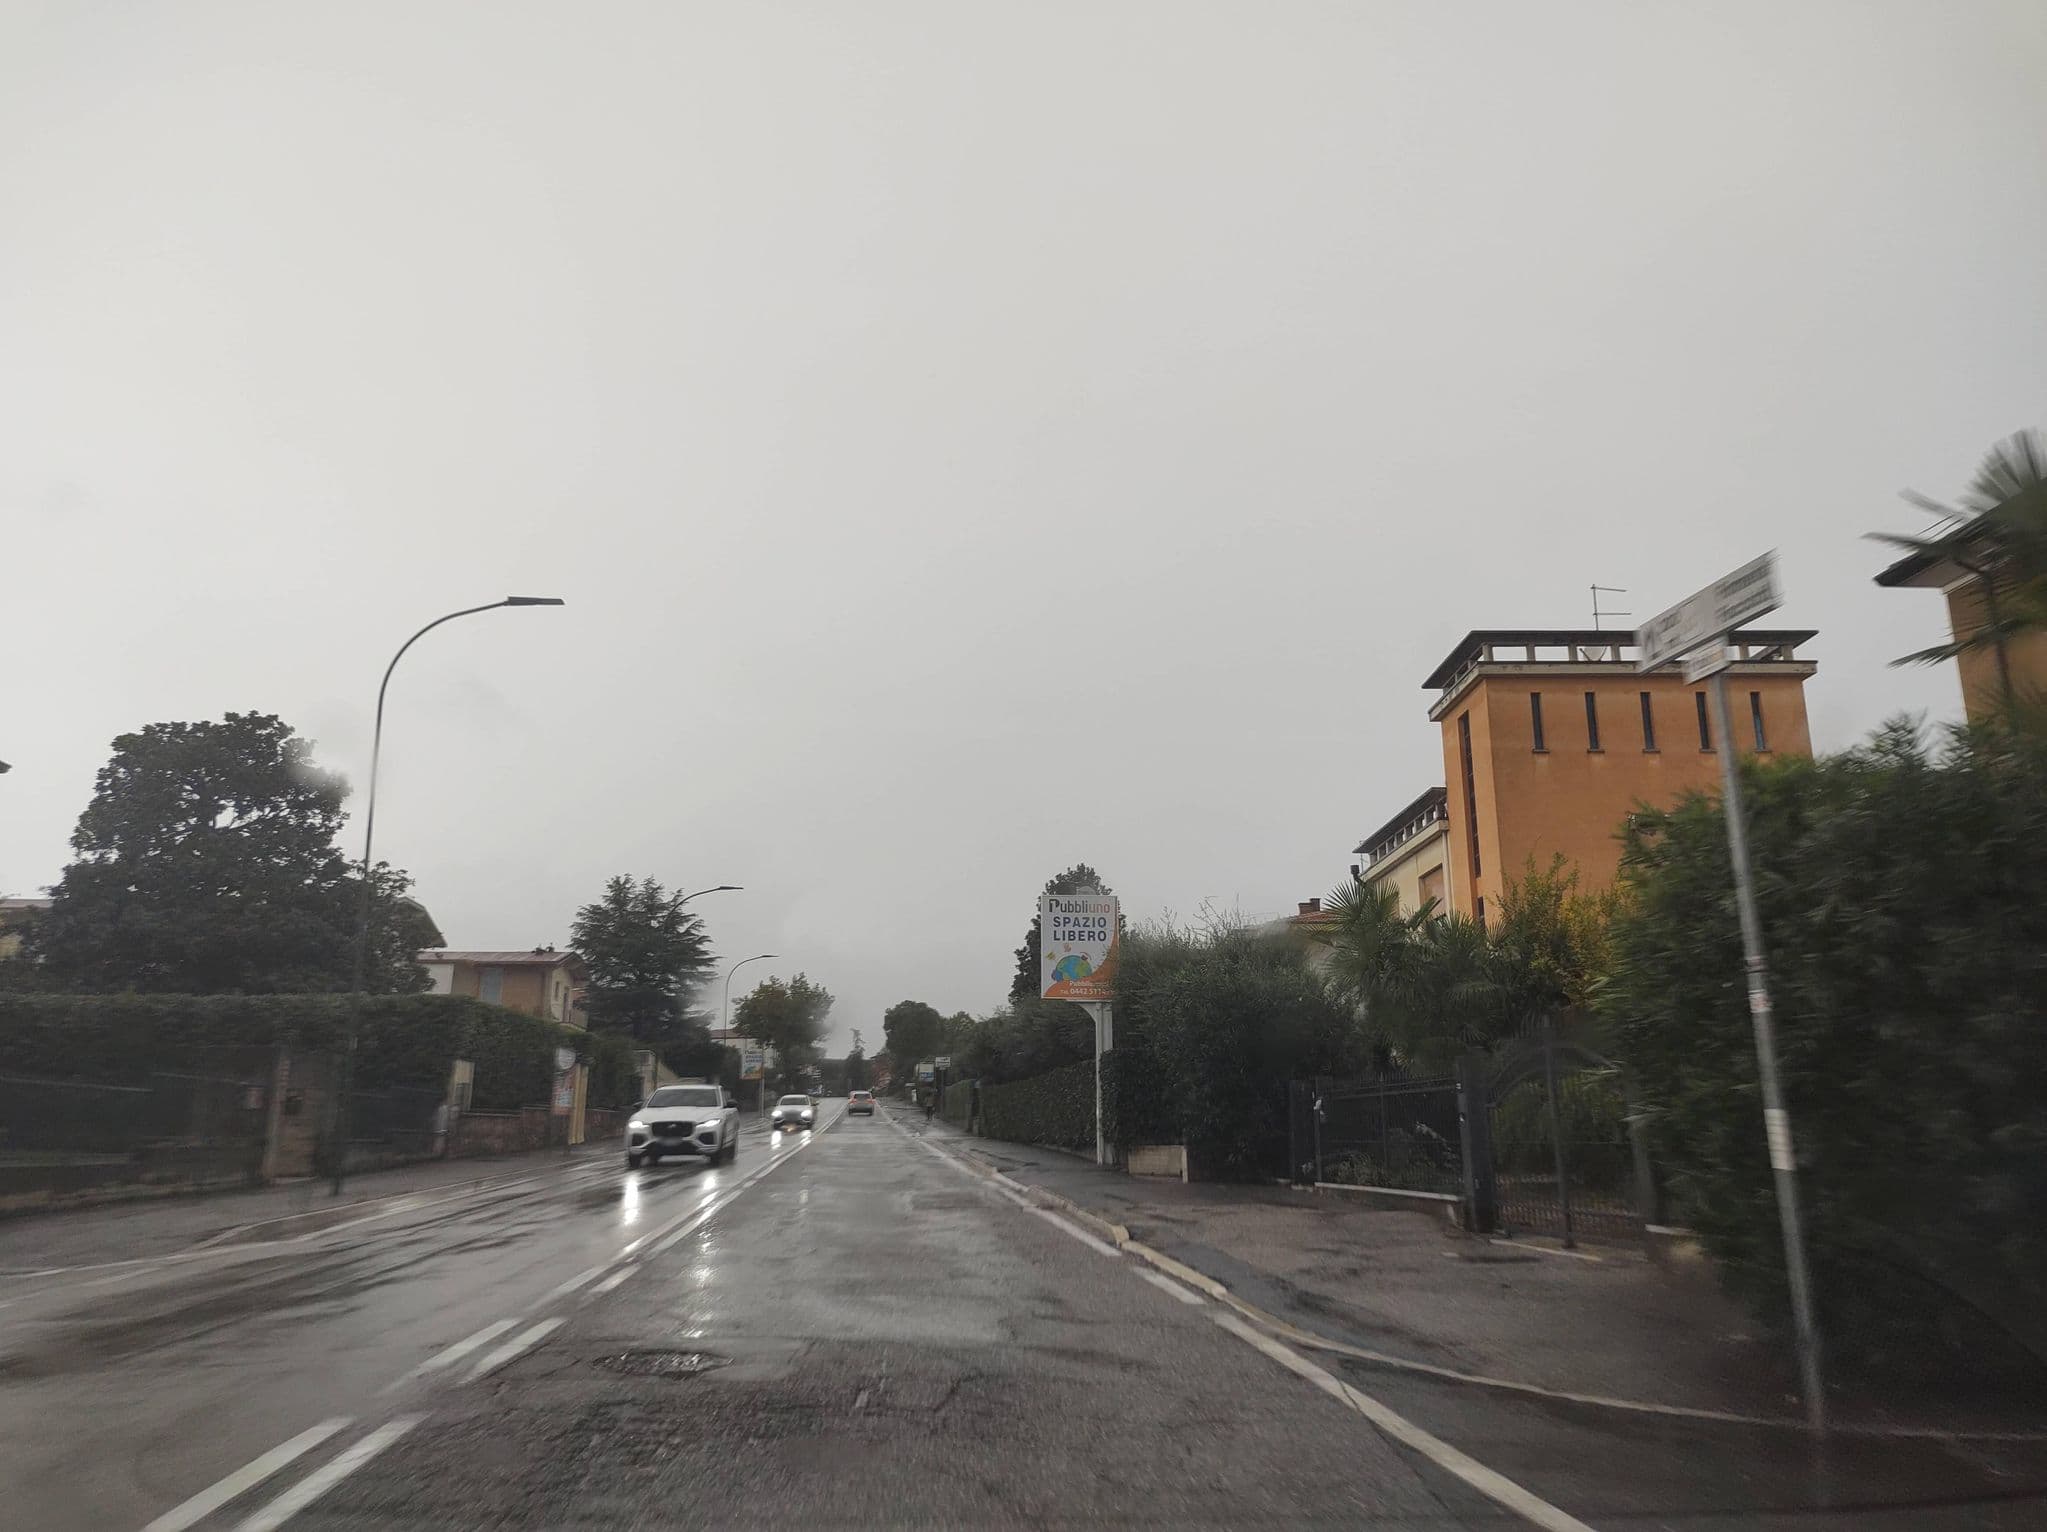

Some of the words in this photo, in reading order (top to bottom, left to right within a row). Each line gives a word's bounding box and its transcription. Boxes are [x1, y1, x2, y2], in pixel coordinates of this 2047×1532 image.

[1049, 898, 1111, 914] Pubbliuno
[1053, 916, 1107, 928] SPAZIO
[1053, 930, 1107, 942] LIBERO
